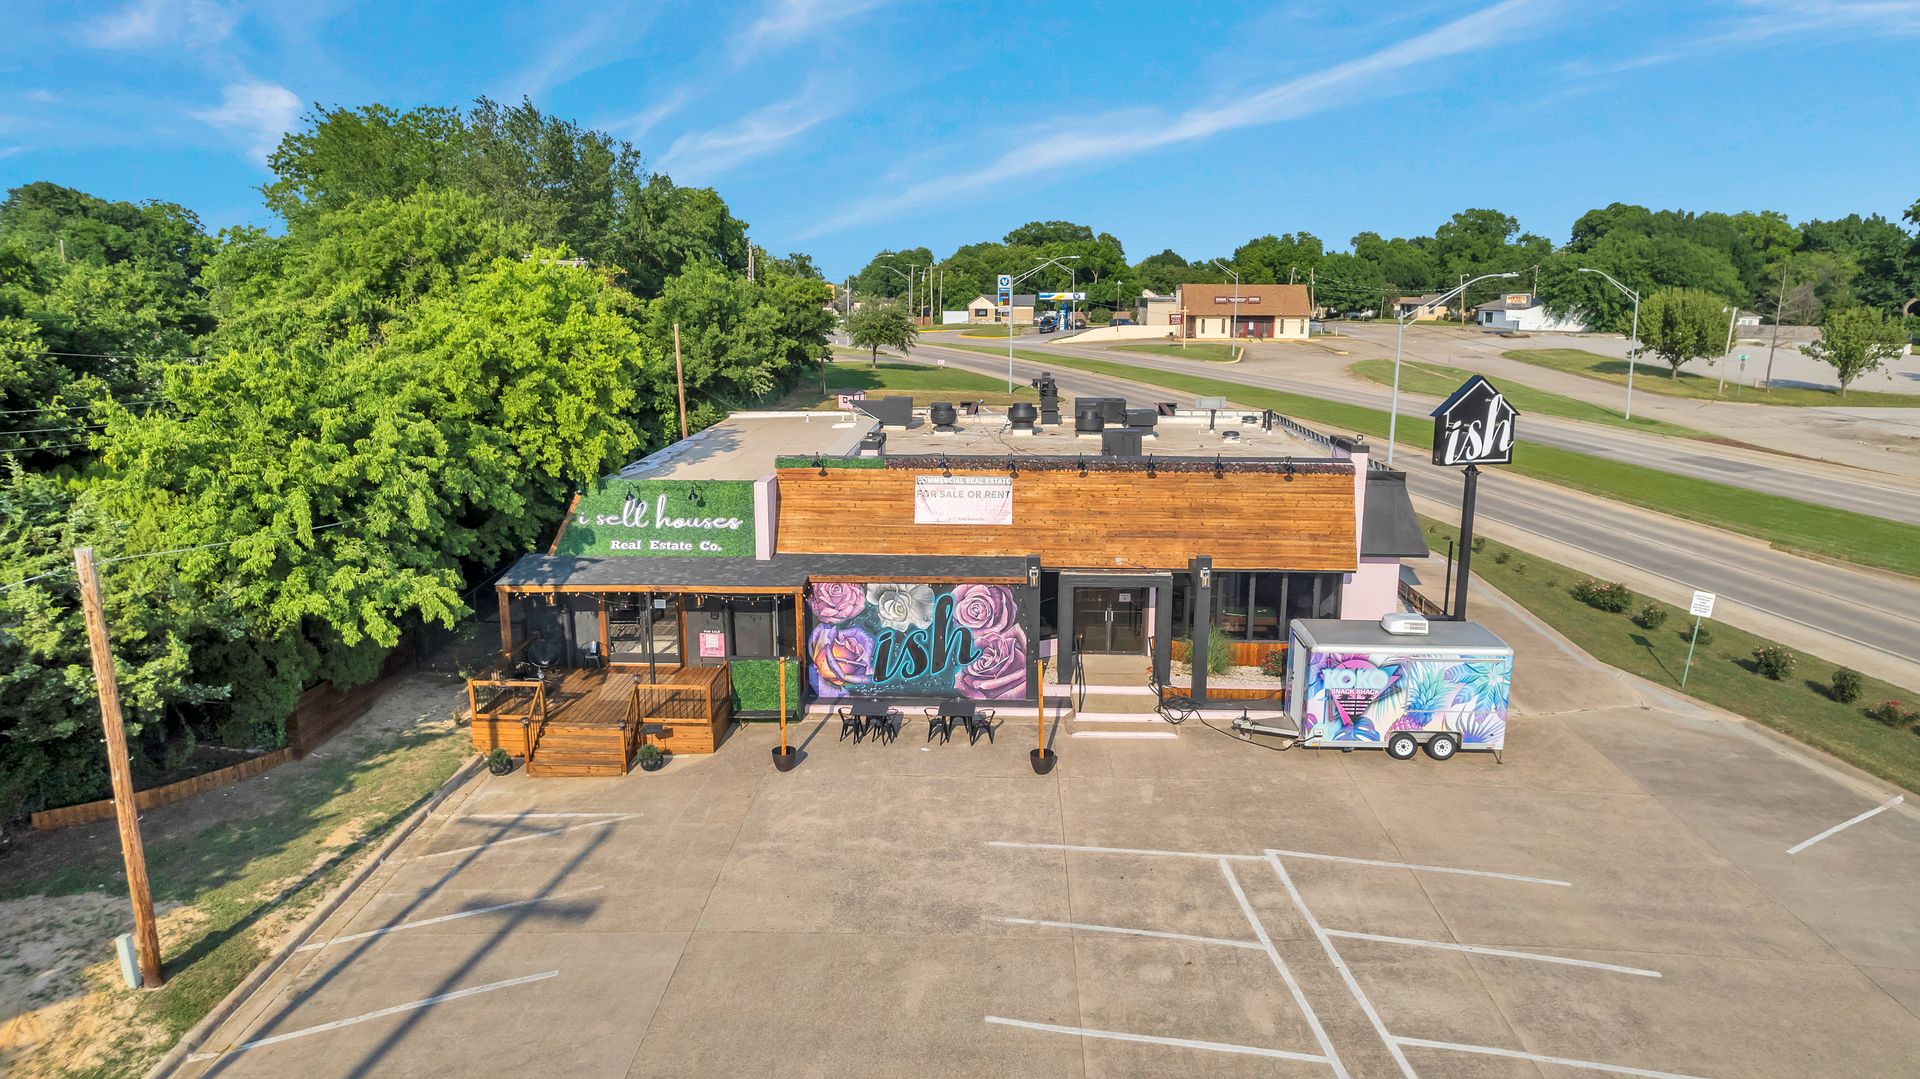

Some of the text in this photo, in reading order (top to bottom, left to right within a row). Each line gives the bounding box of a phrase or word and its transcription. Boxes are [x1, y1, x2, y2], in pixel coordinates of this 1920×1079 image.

[1445, 394, 1514, 464] ish
[917, 490, 1010, 498] FOR SALE OR RENT
[578, 494, 744, 530] i sell houses
[610, 540, 722, 551] Real Estate Co.
[872, 592, 981, 684] ish
[1322, 668, 1388, 689] KOKO
